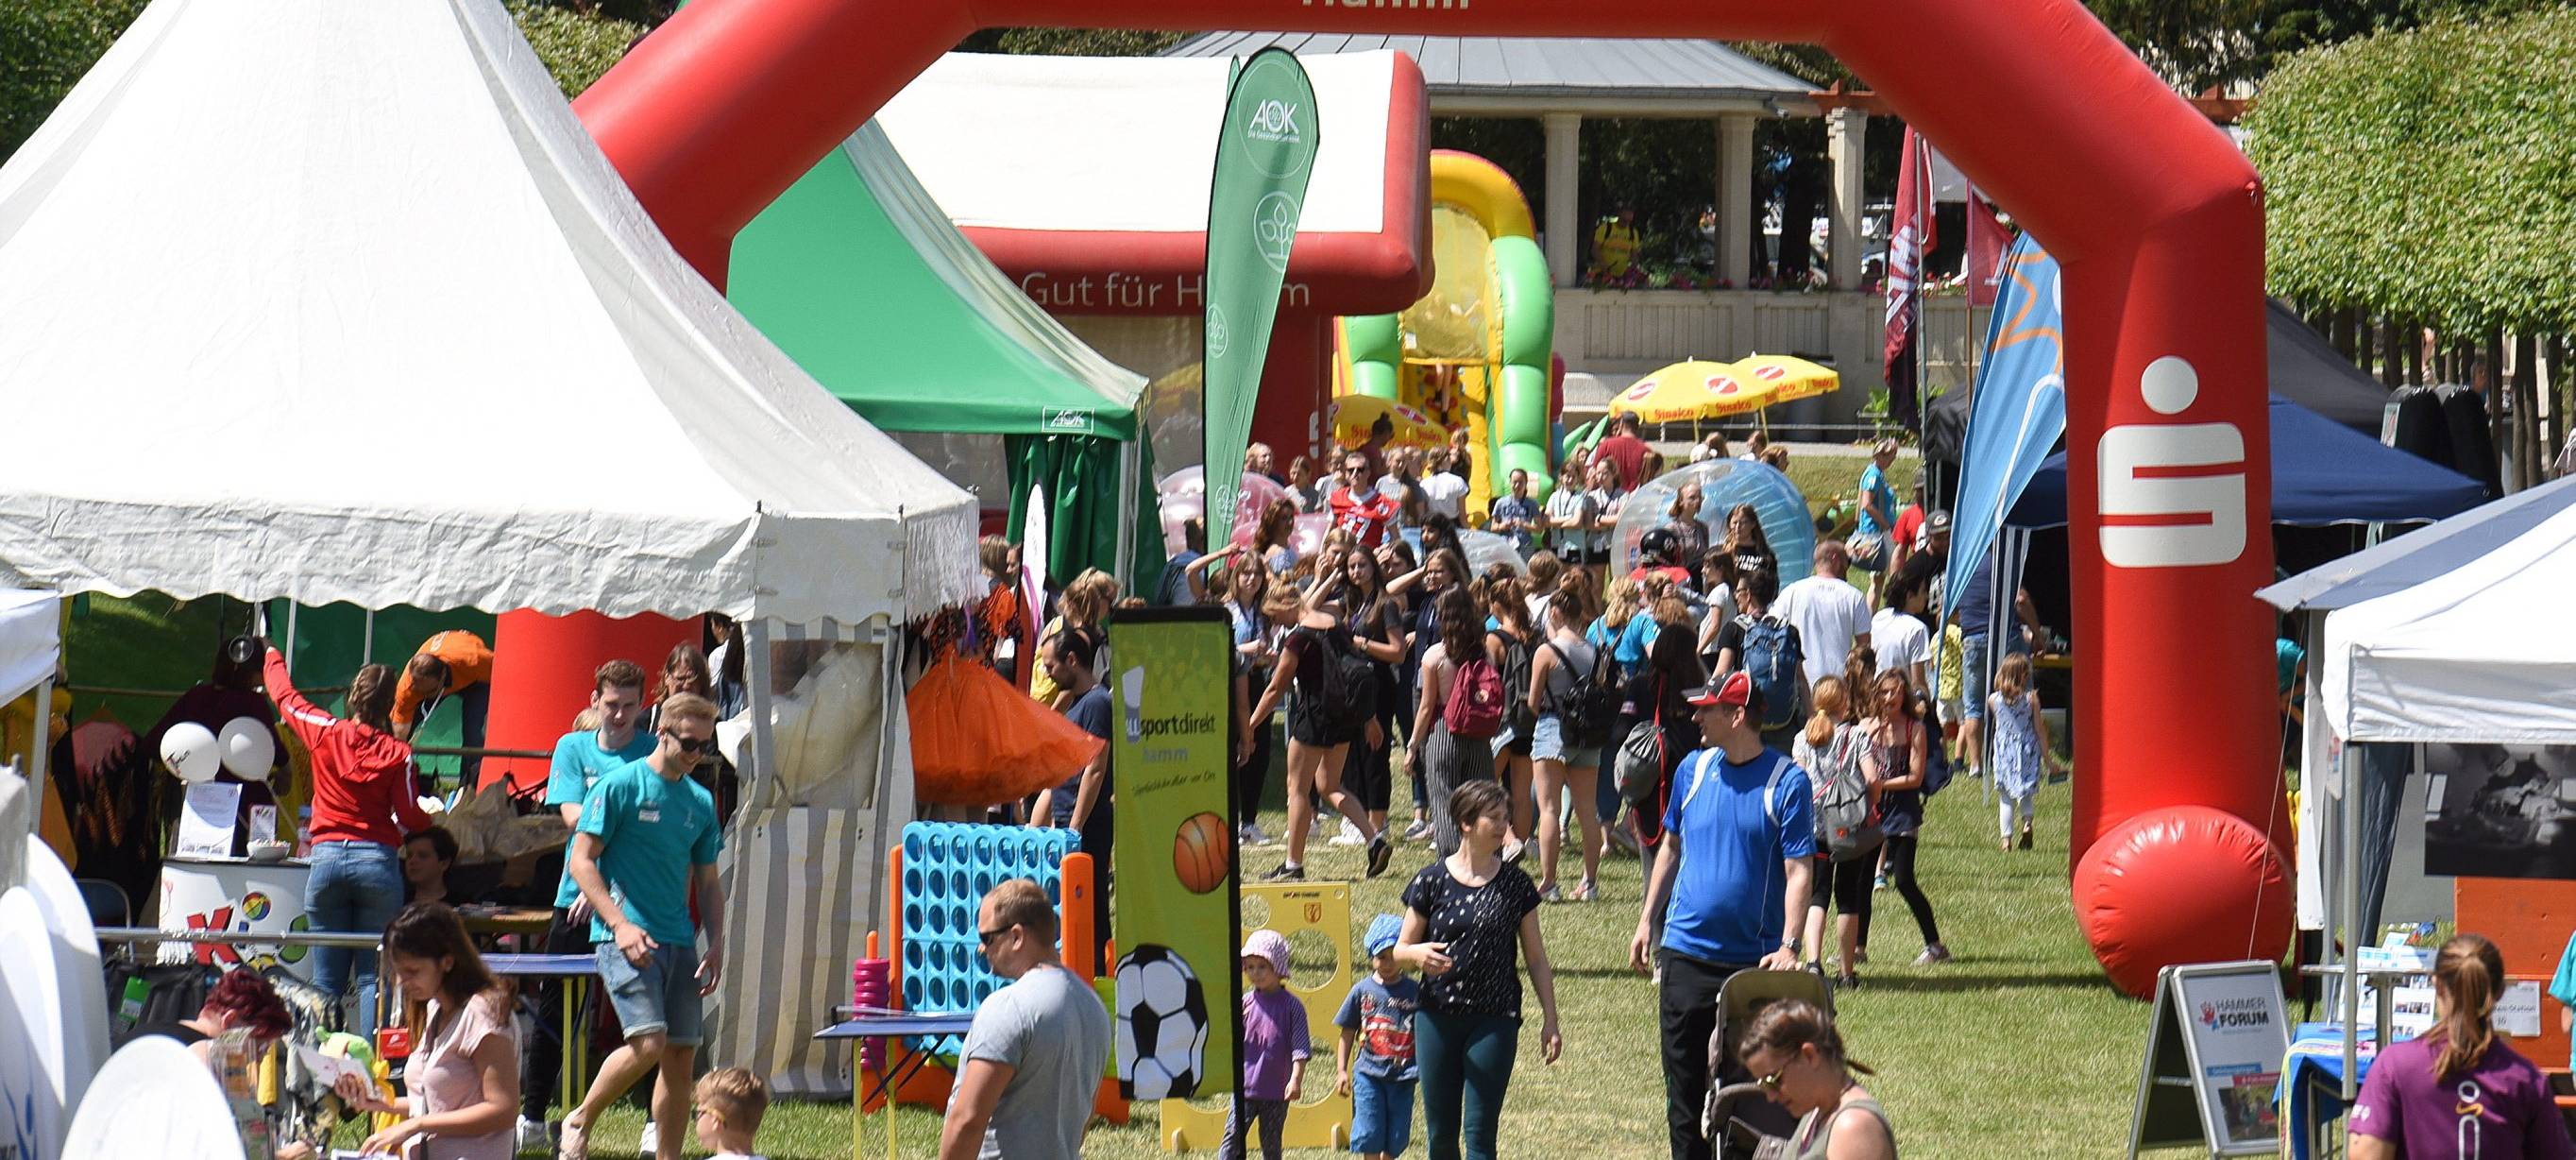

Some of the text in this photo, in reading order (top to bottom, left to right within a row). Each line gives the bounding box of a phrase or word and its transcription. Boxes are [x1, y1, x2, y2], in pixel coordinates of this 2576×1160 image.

[1247, 99, 1299, 134] AOK
[1021, 272, 1310, 306] Gut für Hm
[1050, 409, 1085, 426] AOK
[1654, 407, 1694, 421] Sinalco
[2216, 997, 2266, 1012] HAMMER
[2219, 1011, 2269, 1028] FORUM
